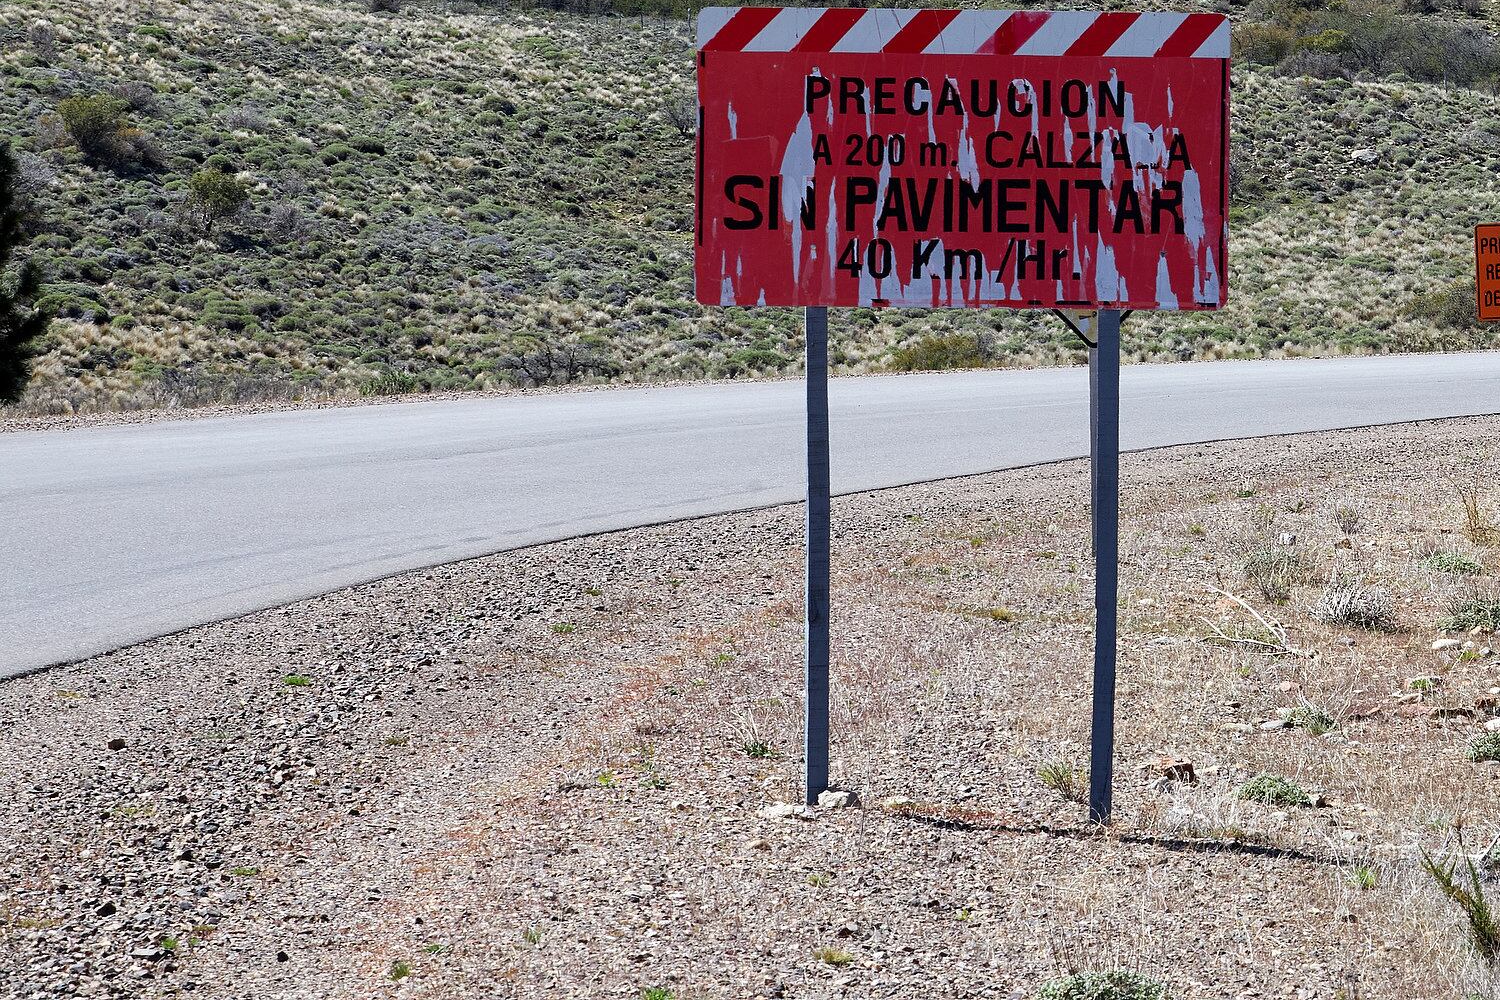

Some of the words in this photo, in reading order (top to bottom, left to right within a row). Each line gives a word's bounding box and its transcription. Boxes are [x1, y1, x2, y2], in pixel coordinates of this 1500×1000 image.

[806, 76, 1125, 119] PRECAUCION
[813, 133, 833, 166] A
[845, 133, 906, 167] 200
[985, 130, 1193, 170] CALZAA
[845, 175, 1186, 235] PAVIMENTAR
[837, 237, 894, 280] 40
[1484, 289, 1500, 307] DE
